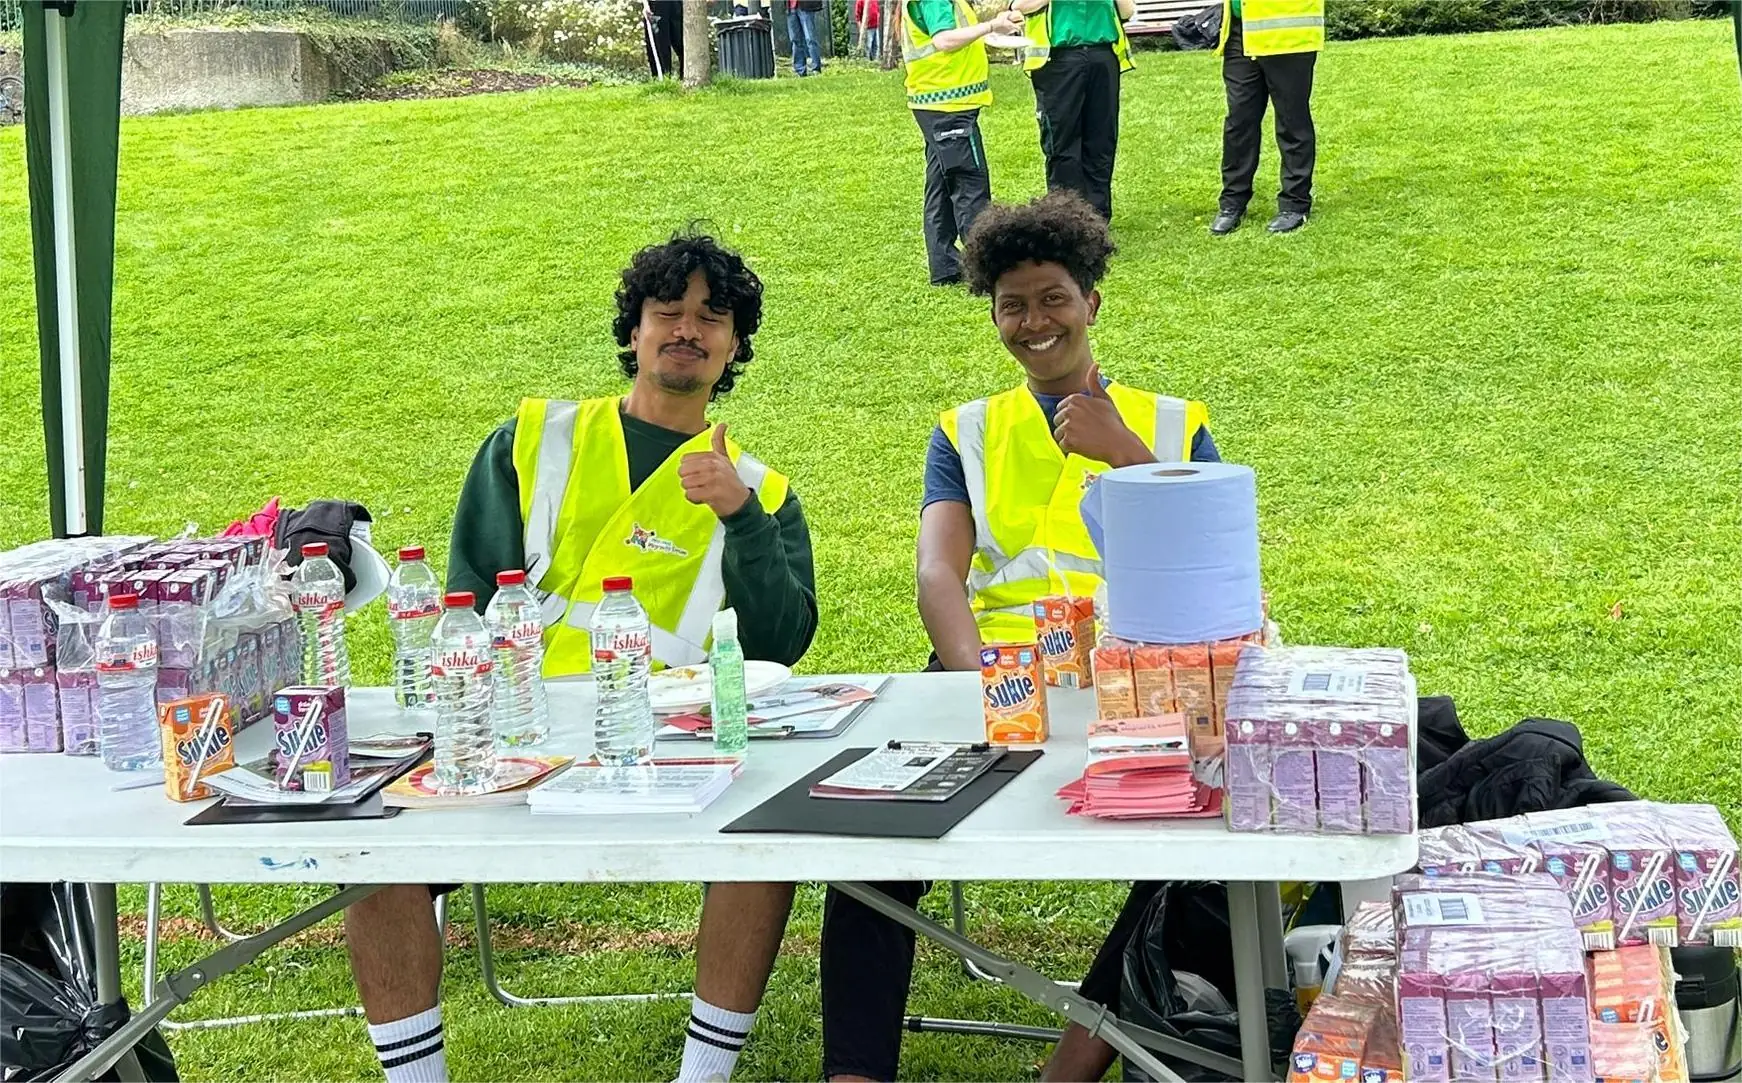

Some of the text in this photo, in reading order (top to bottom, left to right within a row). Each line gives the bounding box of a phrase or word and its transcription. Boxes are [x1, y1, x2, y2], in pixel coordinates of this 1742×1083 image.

[298, 592, 328, 605] ishka
[441, 651, 478, 667] ishka
[984, 671, 1036, 709] Sukie
